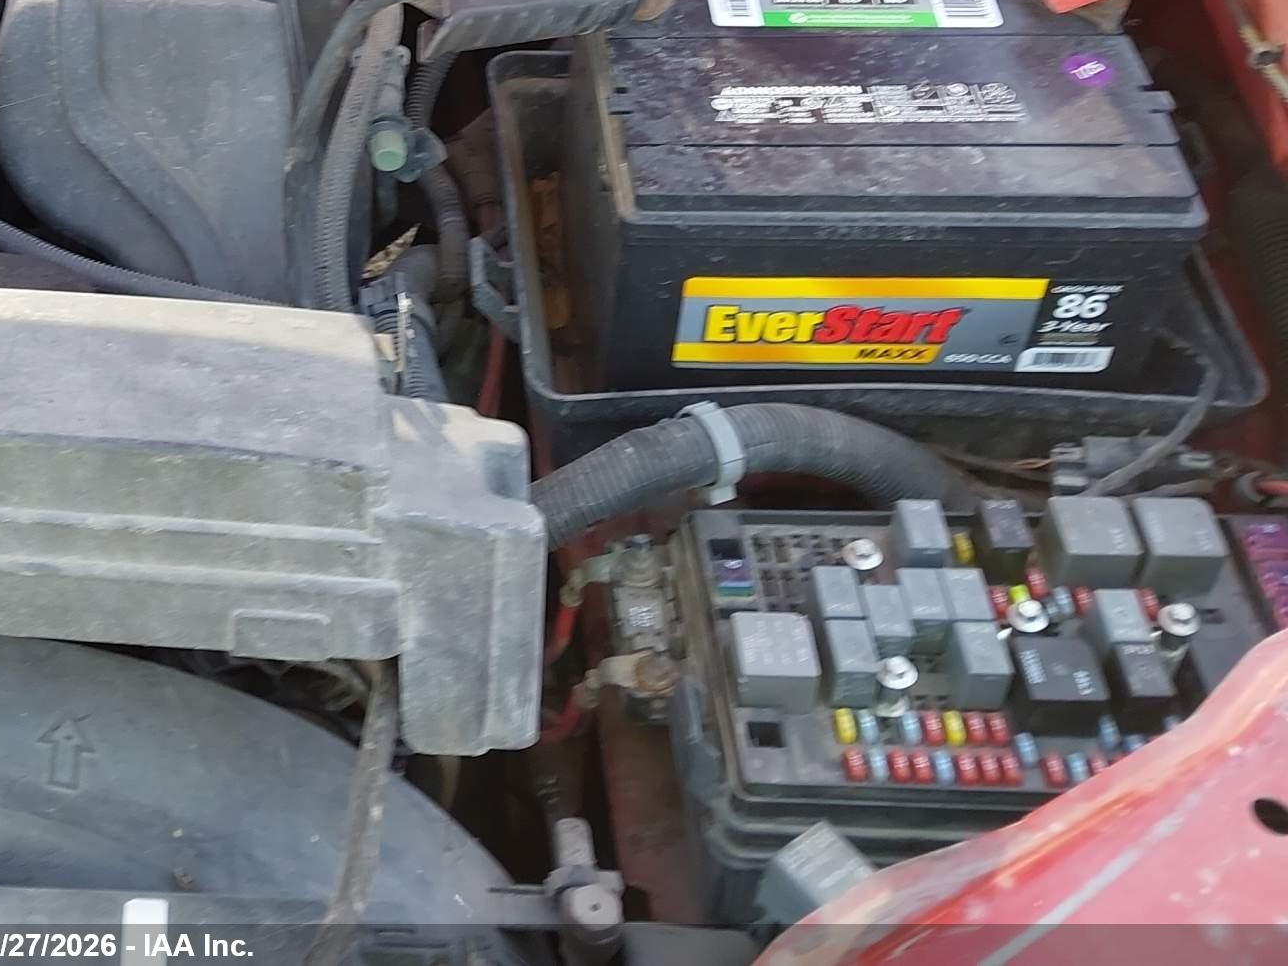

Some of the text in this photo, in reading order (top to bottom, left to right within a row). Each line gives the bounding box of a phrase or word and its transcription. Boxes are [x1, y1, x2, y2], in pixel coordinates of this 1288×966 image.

[1052, 293, 1111, 319] 86
[703, 305, 969, 344] EverStart
[855, 346, 930, 360] MAXX
